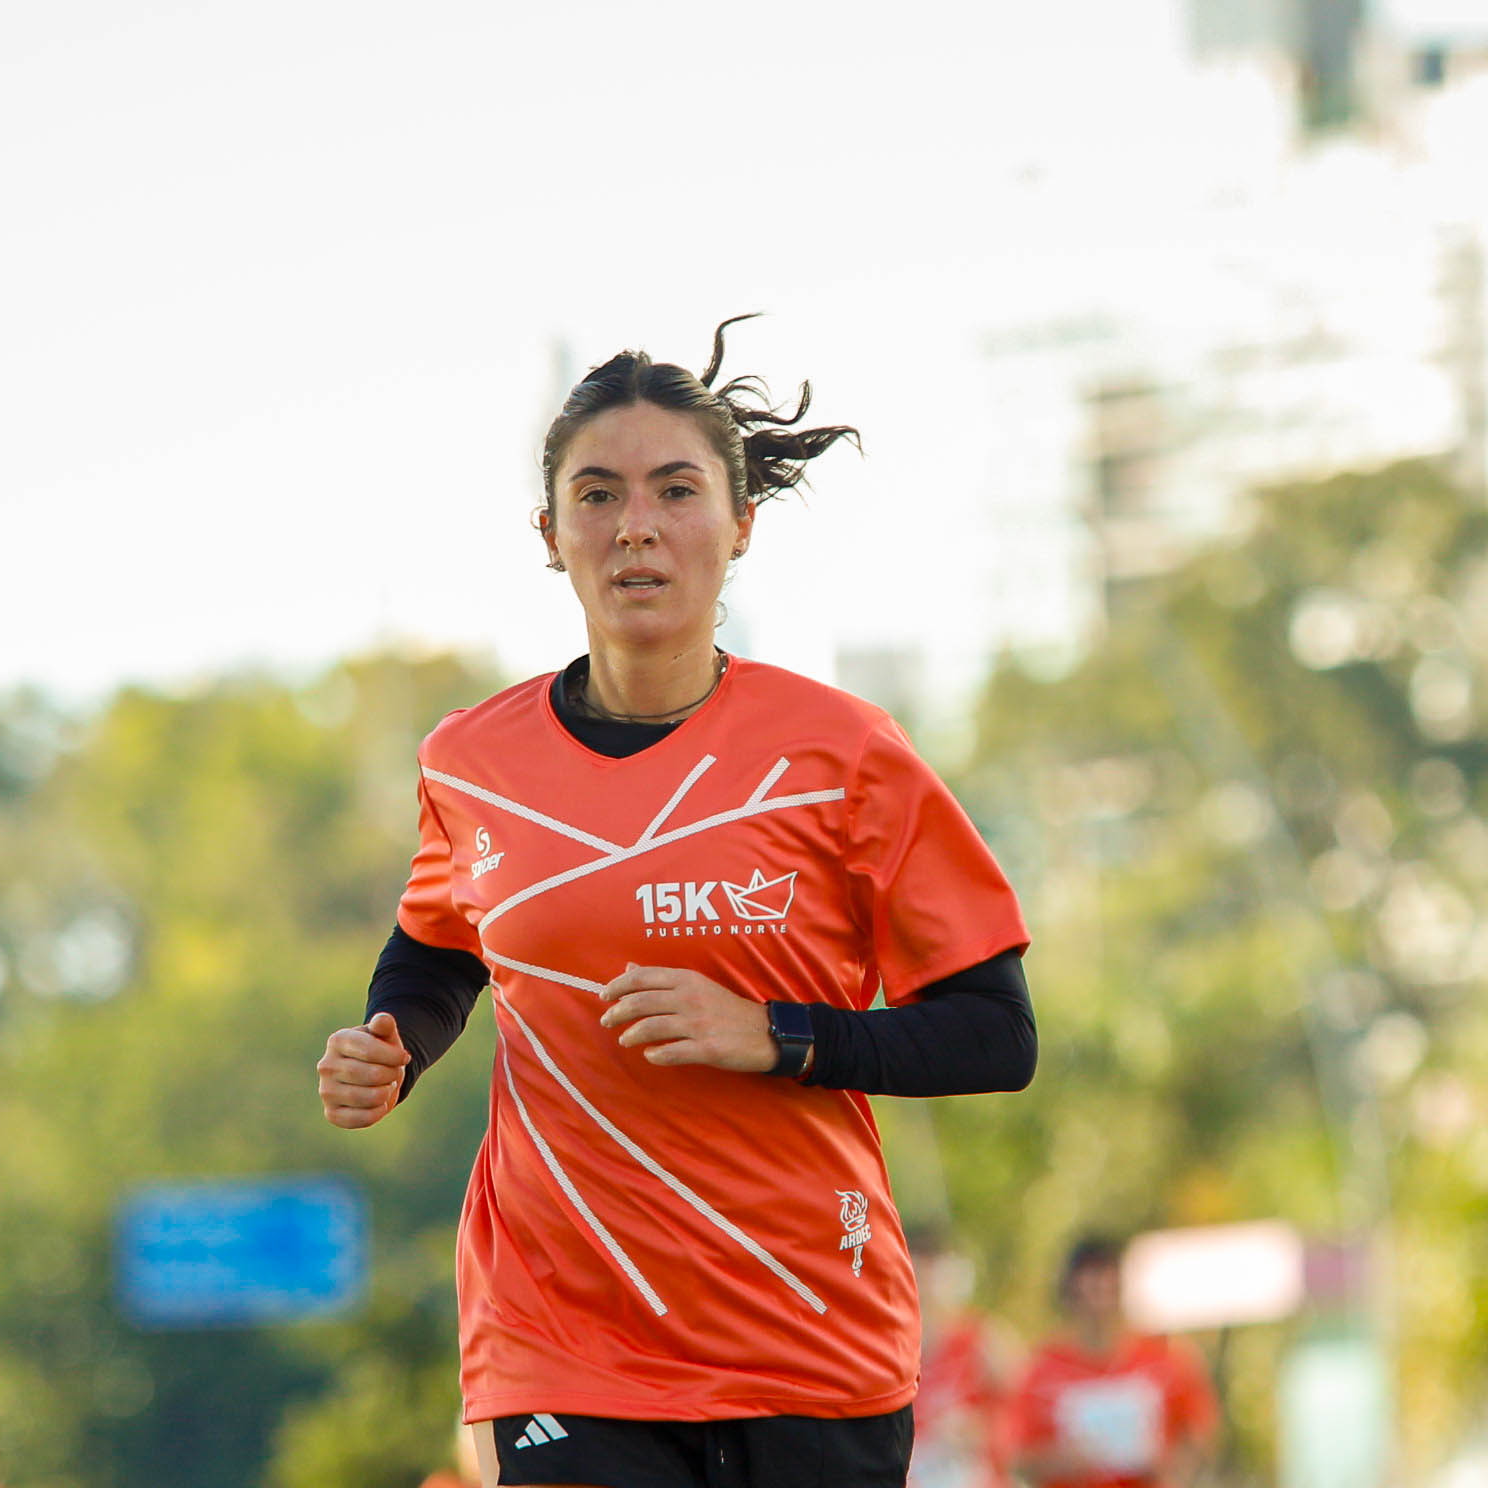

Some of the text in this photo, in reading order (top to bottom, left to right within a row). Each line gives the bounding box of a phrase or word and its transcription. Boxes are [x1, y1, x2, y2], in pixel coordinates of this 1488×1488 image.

[635, 881, 720, 924] 15K
[645, 924, 788, 938] PUERTO NORTE
